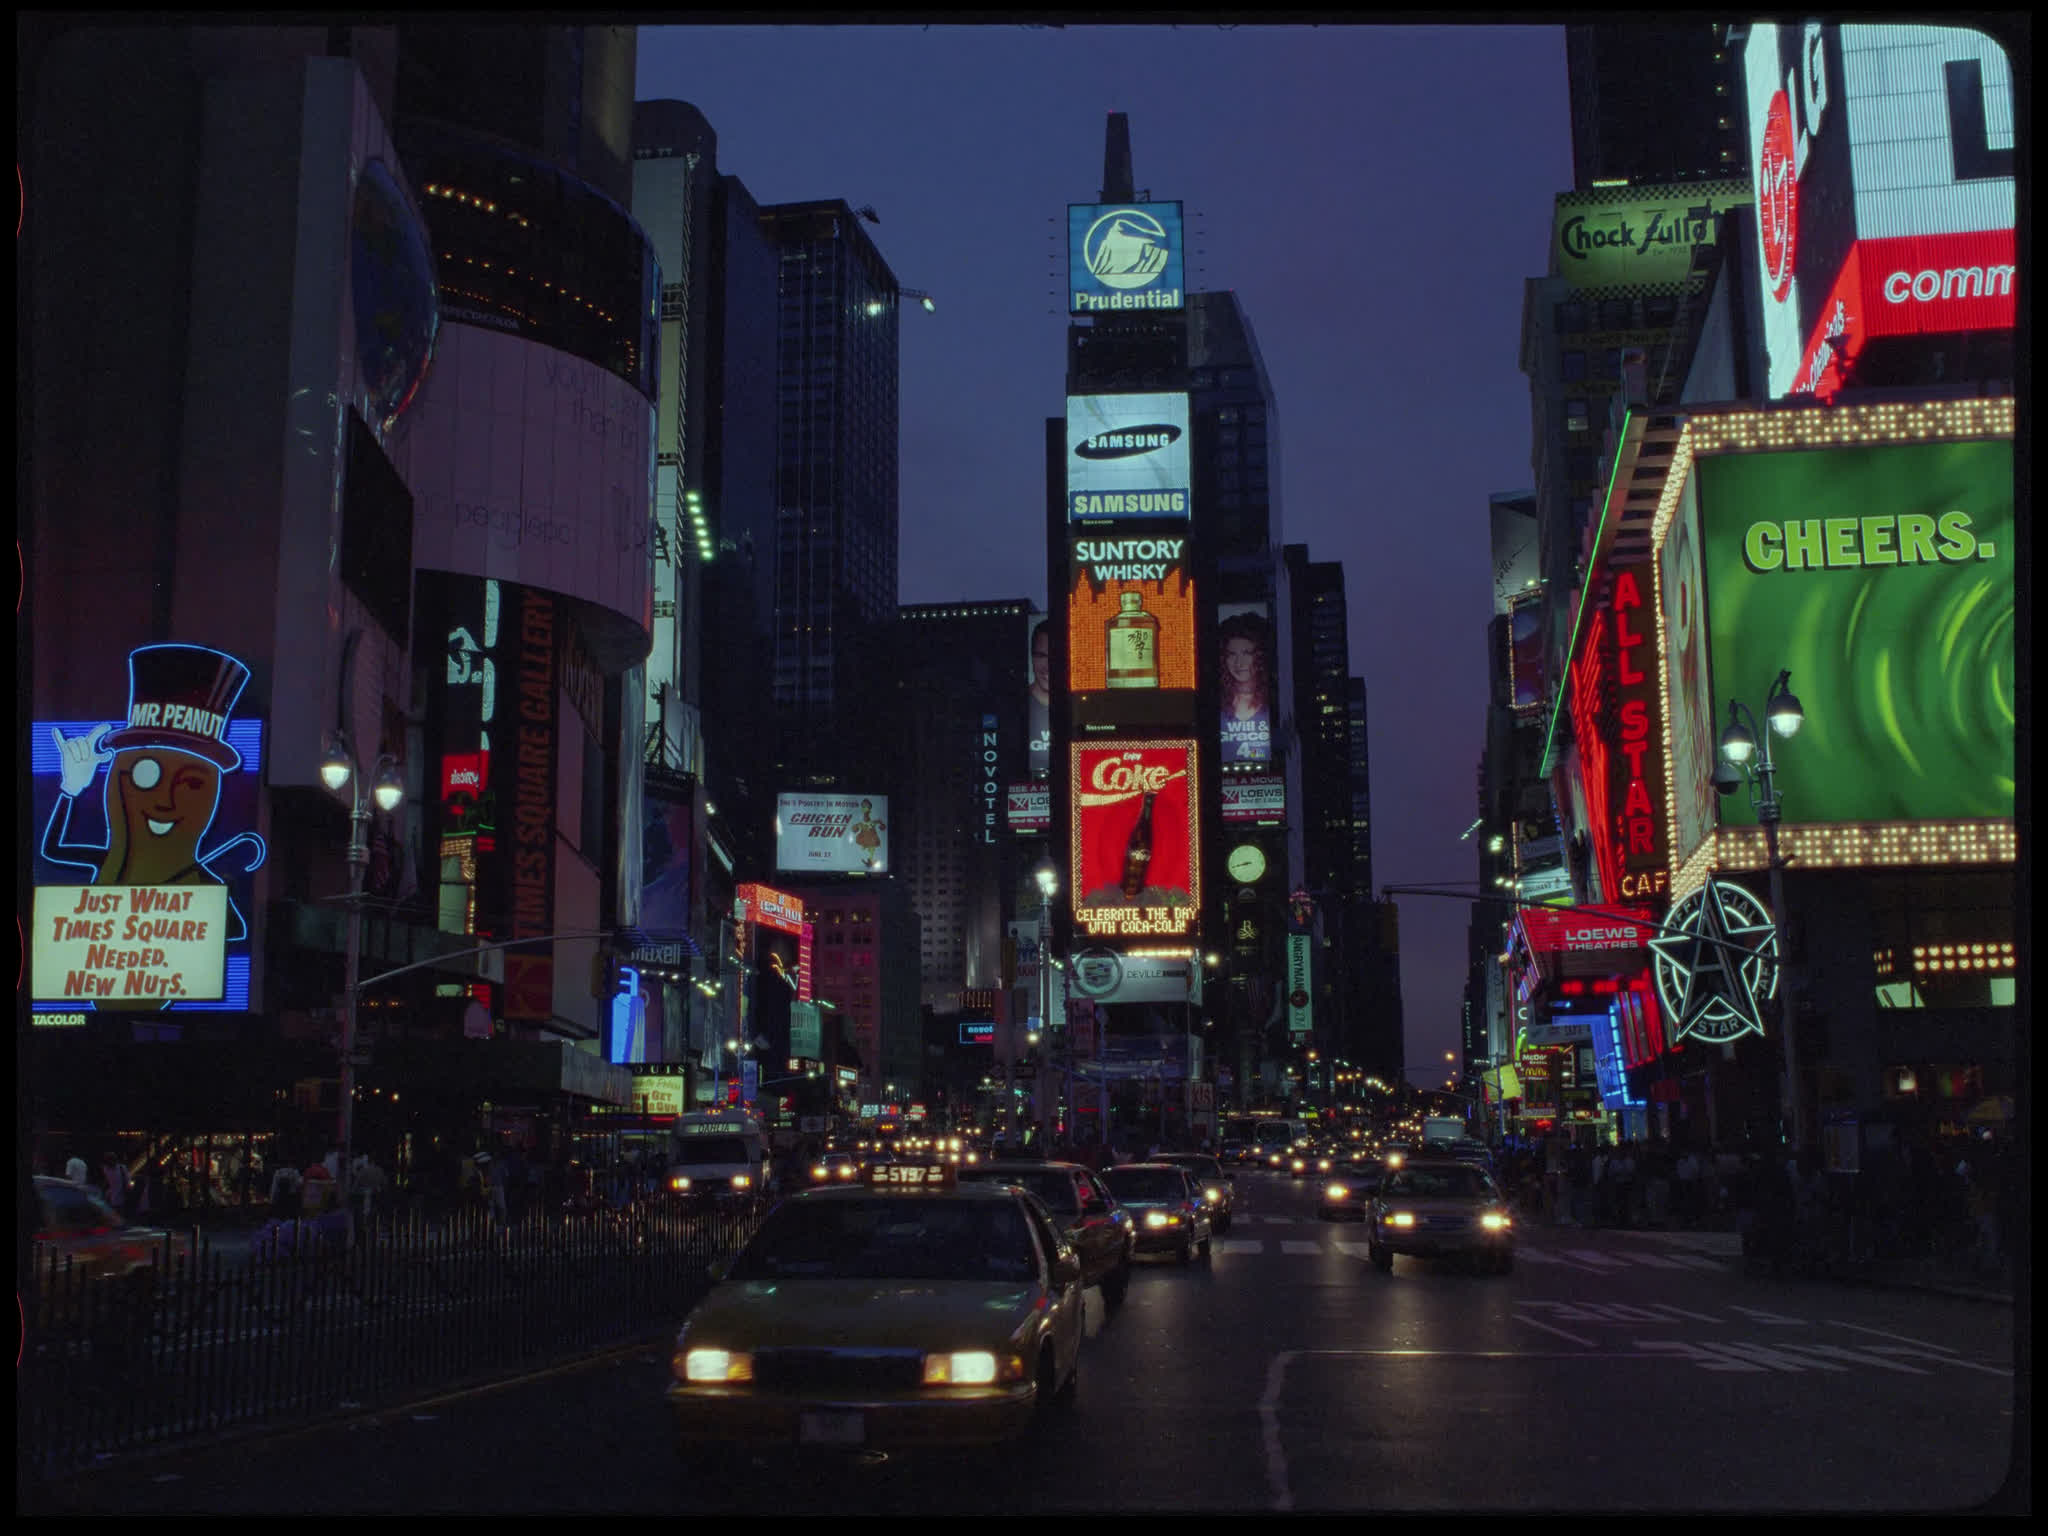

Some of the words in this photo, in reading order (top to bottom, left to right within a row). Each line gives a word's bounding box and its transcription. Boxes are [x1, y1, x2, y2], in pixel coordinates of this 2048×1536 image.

[1561, 215, 1637, 260] Chock
[1075, 289, 1180, 310] Prudential
[1087, 433, 1170, 449] SAMSUNG
[1074, 493, 1185, 514] SAMSUNG
[1075, 539, 1185, 562] SUNTORY
[1744, 511, 1996, 572] CHEERS.
[1093, 563, 1168, 581] WHISKY
[1614, 571, 1645, 687] ALL
[519, 590, 553, 721] GALLERY
[131, 702, 162, 729] MR.
[162, 703, 225, 741] PEANUT
[1227, 720, 1256, 732] Will
[1091, 756, 1170, 792] Coke
[1619, 701, 1655, 854] STAR
[514, 728, 552, 844] SQUARE
[983, 731, 998, 844] NOVOTEL
[1241, 788, 1284, 798] LOEWS
[790, 812, 853, 824] CHICKEN
[808, 825, 847, 838] RUN
[73, 888, 123, 915] JUST
[129, 887, 193, 914] WHAT
[1075, 908, 1141, 922] CELEBRATE
[1145, 907, 1170, 921] THE
[1173, 906, 1198, 920] DAY
[53, 916, 115, 942] TIMES
[122, 914, 208, 943] SQUARE
[1087, 921, 1117, 934] WITH
[1120, 919, 1188, 934] COCA-COLA!
[1565, 926, 1639, 942] LOEWS
[85, 944, 169, 969] NEEDED.
[1567, 940, 1639, 952] THEATRES
[64, 970, 116, 997] NEW
[124, 970, 187, 997] NUTS.
[1697, 1015, 1741, 1037] STAR
[888, 1166, 927, 1183] 5Y97
